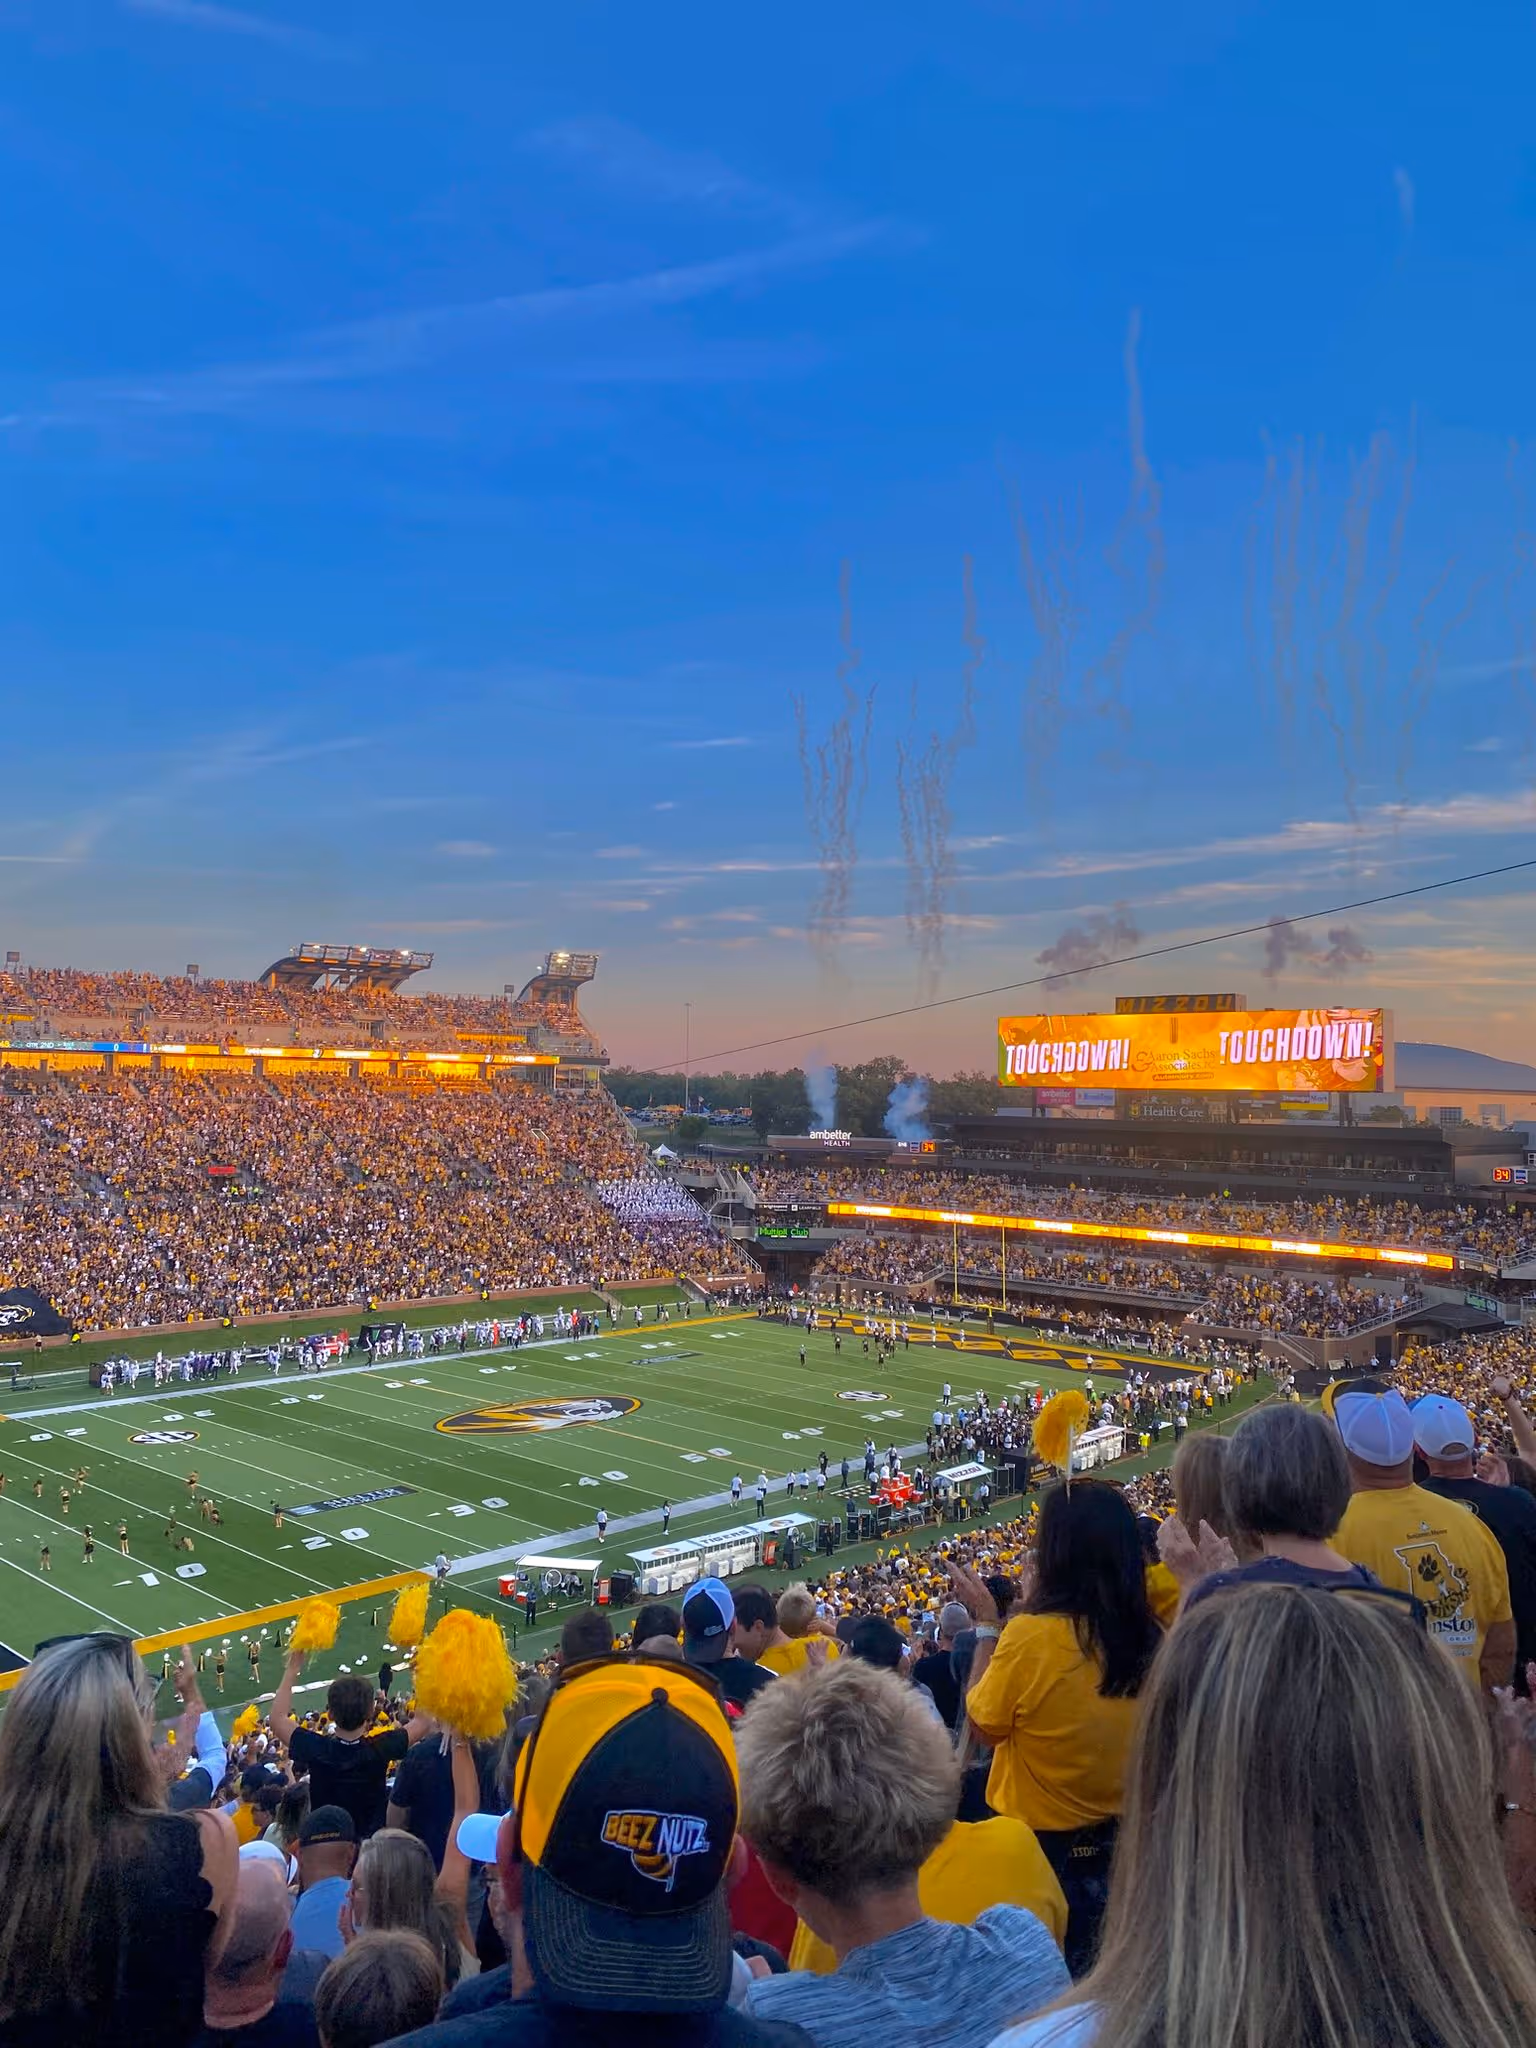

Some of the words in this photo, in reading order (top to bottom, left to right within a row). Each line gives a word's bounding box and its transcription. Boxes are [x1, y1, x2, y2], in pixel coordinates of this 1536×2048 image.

[1118, 995, 1233, 1012] MIZZOU
[1219, 1022, 1373, 1065] TOUCHDOWN!
[1006, 1039, 1130, 1075] TOUCHDOWN!
[1143, 1105, 1177, 1116] Health
[1179, 1105, 1204, 1116] Care
[809, 1130, 852, 1140] ambetter
[1495, 1169, 1509, 1180] 34
[132, 1430, 196, 1445] SEC
[782, 1427, 824, 1440] 40
[679, 1447, 732, 1463] 50
[578, 1470, 629, 1487] 40
[948, 1465, 982, 1480] MIZZOU
[446, 1497, 510, 1517] 30
[301, 1527, 370, 1551] 20
[701, 1529, 749, 1544] TIGERS
[137, 1562, 207, 1587] 10
[1431, 1616, 1474, 1633] nsto
[604, 1814, 657, 1851] BEEZ
[657, 1817, 706, 1858] NUTZ
